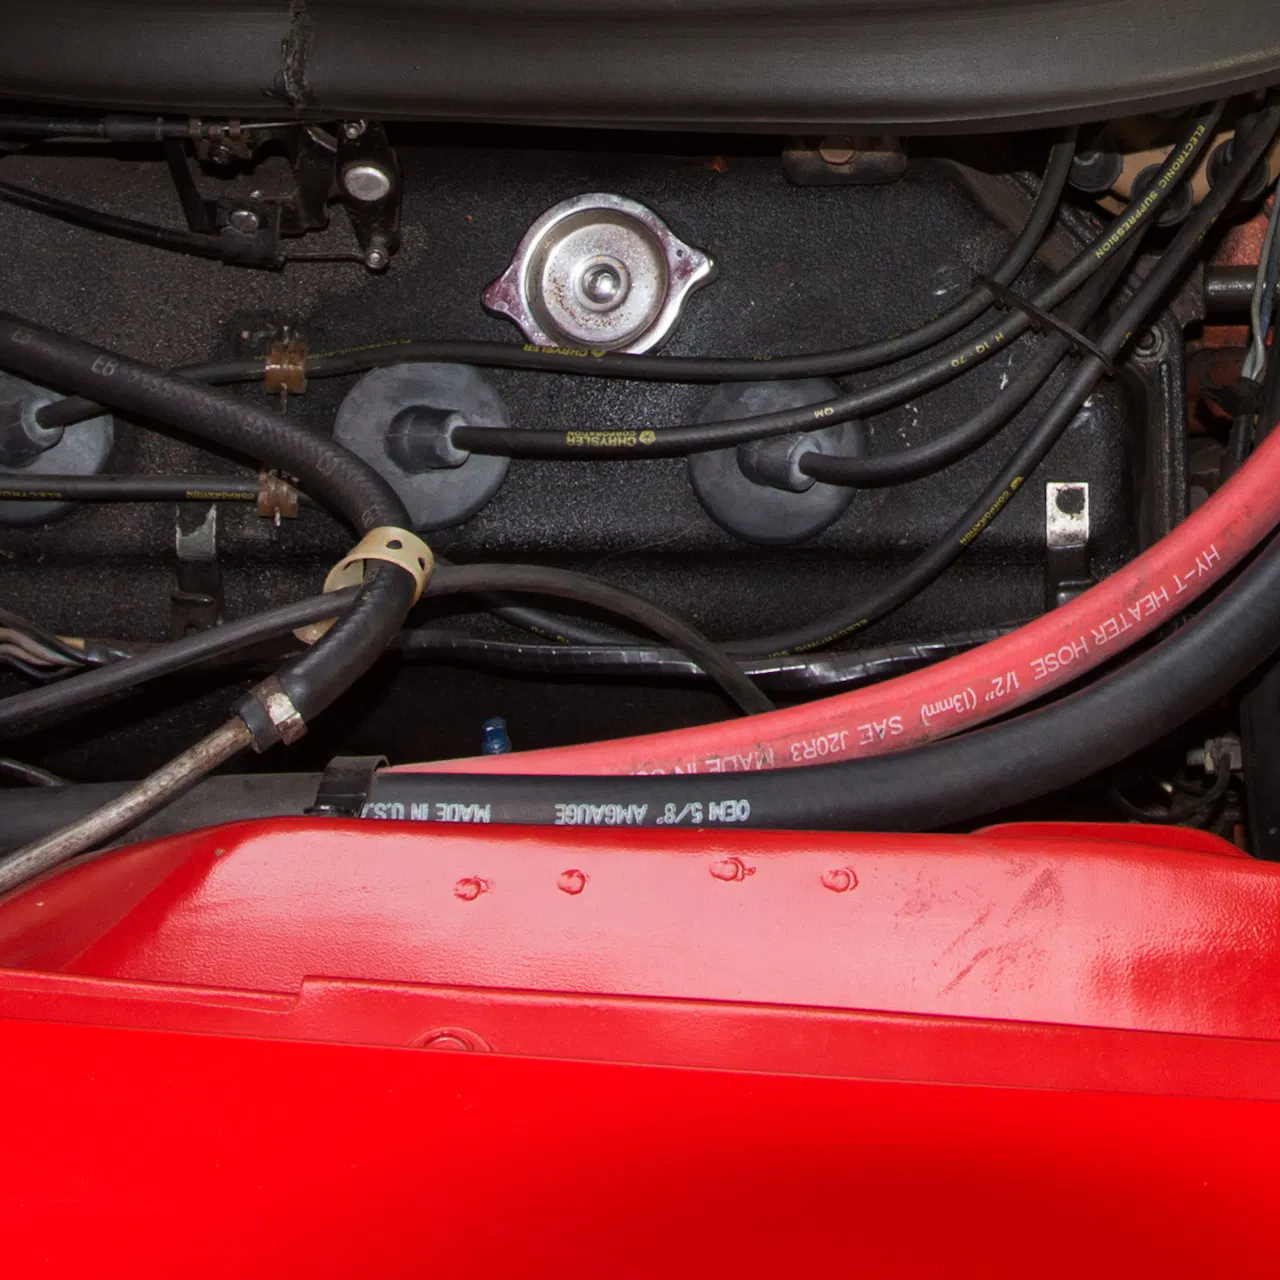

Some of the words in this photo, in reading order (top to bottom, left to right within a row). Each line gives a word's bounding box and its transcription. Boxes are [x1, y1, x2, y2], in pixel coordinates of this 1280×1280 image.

[1158, 124, 1206, 189] ELECTRONIC
[1095, 190, 1158, 259] SUPPRESSION
[566, 434, 637, 446] CHRYSLER
[959, 490, 1011, 545] CORPORATION
[1174, 544, 1221, 595] HY-T
[1091, 586, 1169, 645] HEATER
[1030, 636, 1089, 680] HOSE
[920, 687, 978, 727] (13mm)
[790, 732, 849, 762] J20R3
[859, 715, 904, 747] SAE
[705, 747, 775, 774] MADE
[410, 802, 429, 821] IN
[435, 803, 491, 823] MADE
[554, 803, 648, 826] AMGAUGE
[709, 799, 751, 821] OEM
